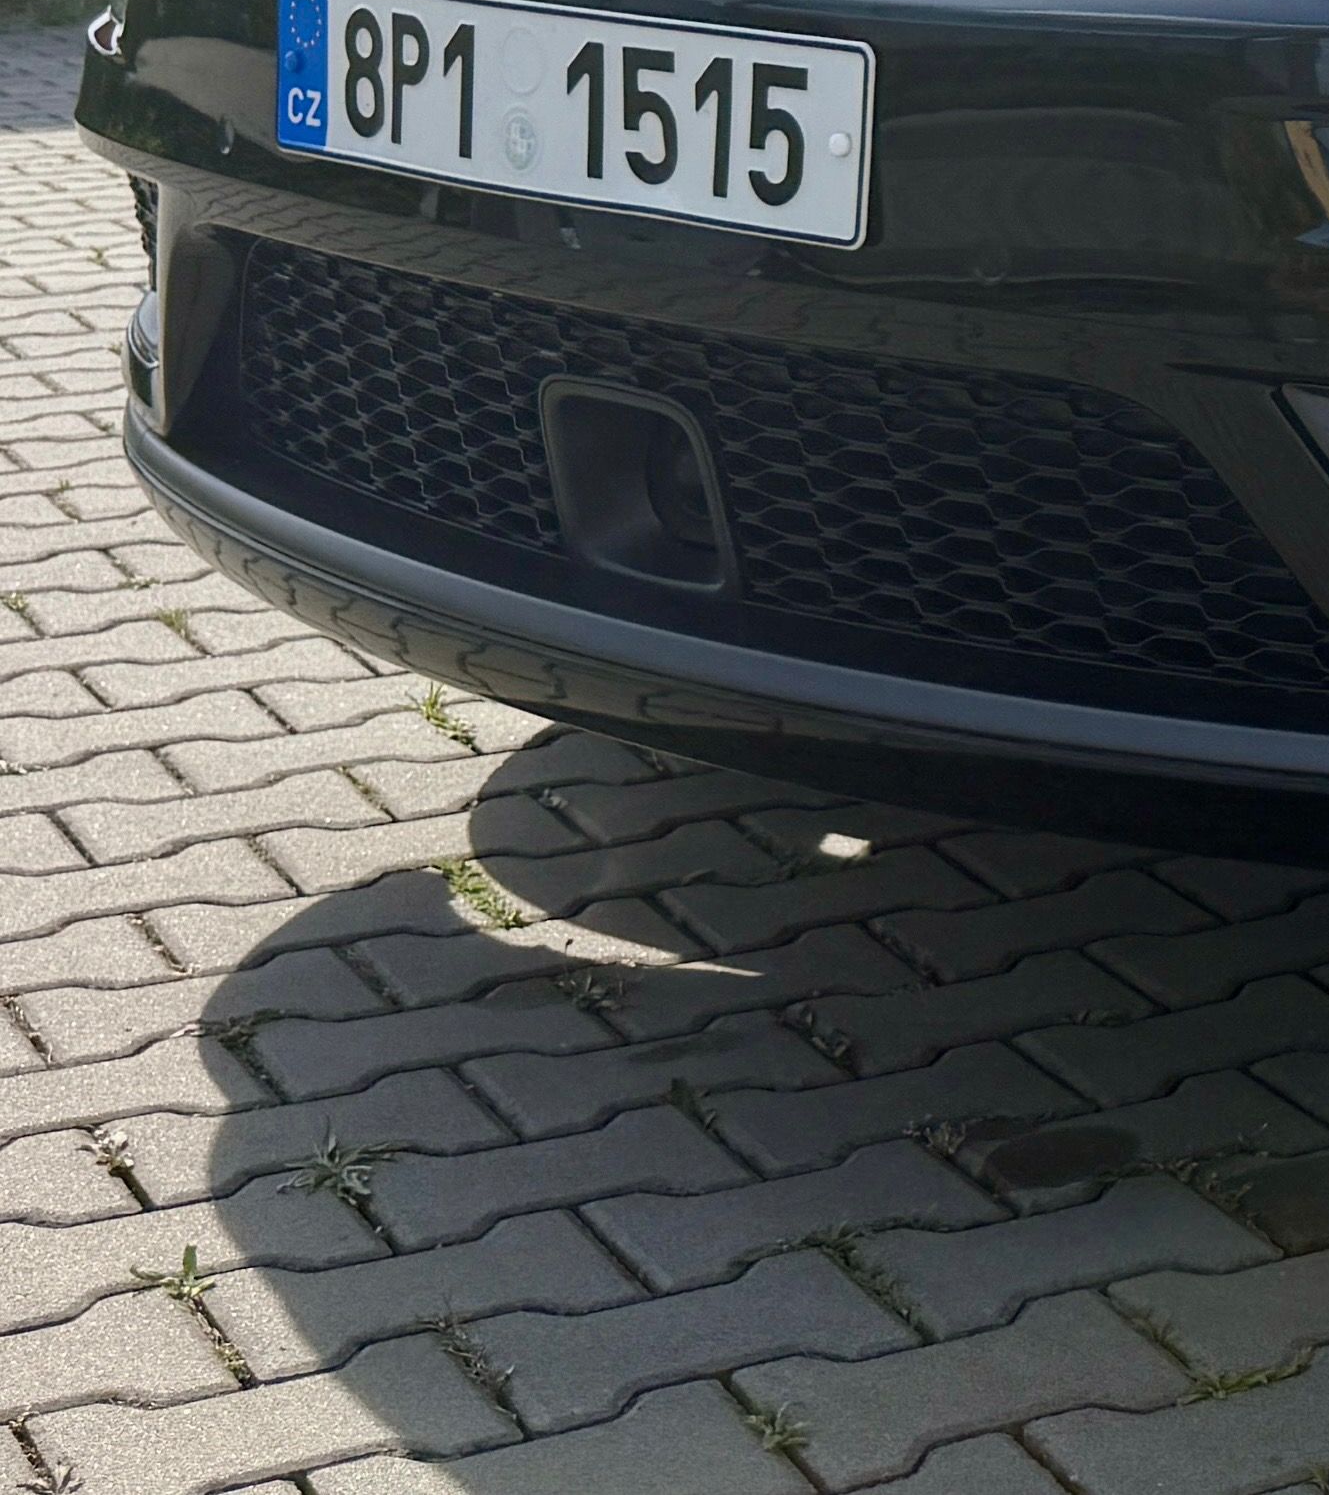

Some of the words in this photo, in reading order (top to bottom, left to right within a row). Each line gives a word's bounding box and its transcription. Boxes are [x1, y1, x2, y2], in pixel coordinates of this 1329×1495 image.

[287, 86, 322, 129] CZ
[344, 7, 476, 160] 8P1
[566, 41, 809, 208] 1515
